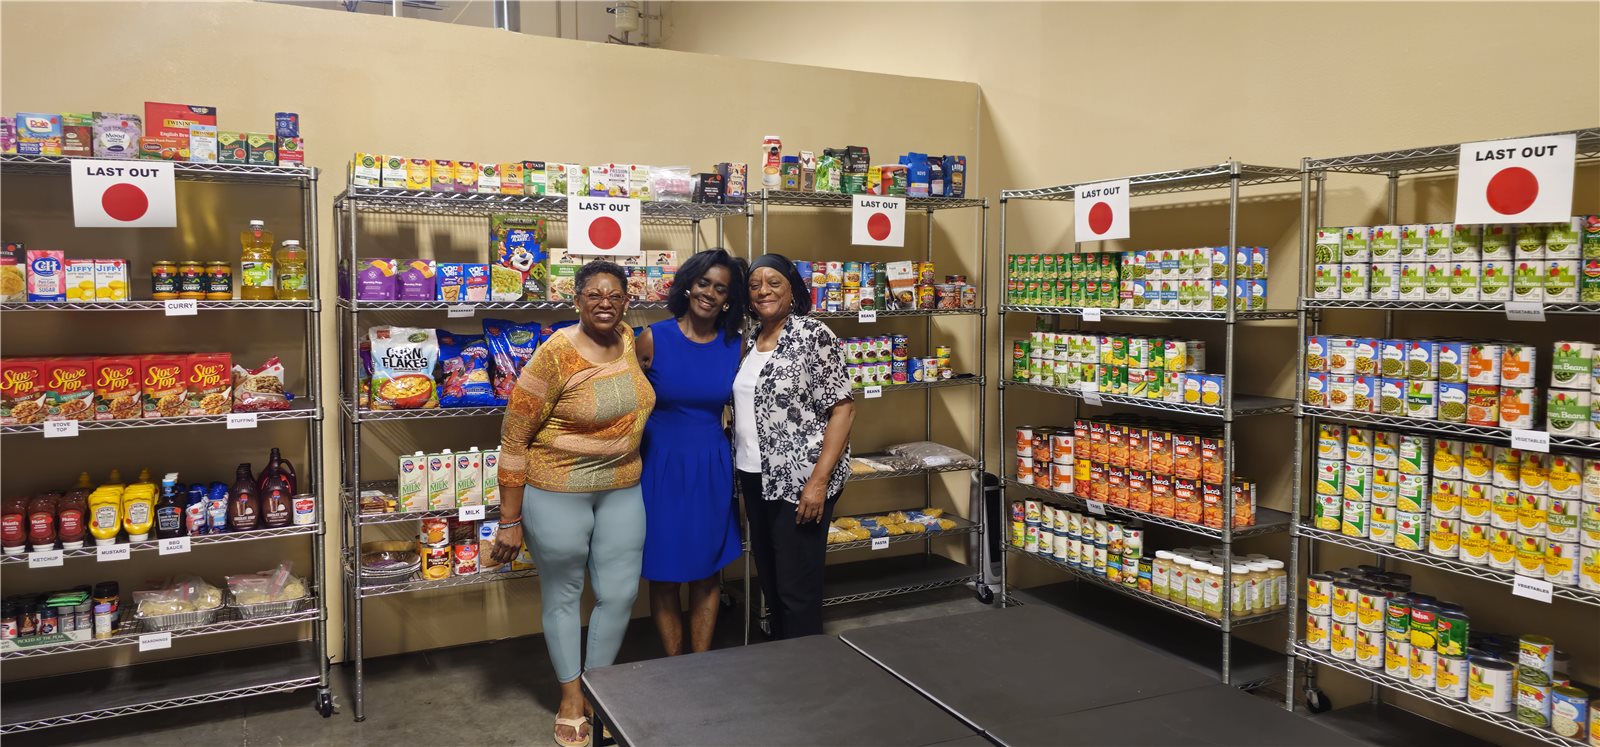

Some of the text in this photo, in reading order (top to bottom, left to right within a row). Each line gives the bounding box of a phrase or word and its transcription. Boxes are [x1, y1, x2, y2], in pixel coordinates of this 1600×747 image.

[30, 119, 49, 129] Dole
[167, 120, 194, 128] TWINING
[1474, 145, 1559, 162] LAST OUT
[86, 166, 160, 178] LAST OUT
[1081, 186, 1121, 199] LAST OUT
[578, 202, 631, 213] LAST OUT
[860, 200, 880, 208] LAST
[66, 265, 94, 273] JIFFY
[381, 357, 428, 369] FLAKES
[1563, 363, 1588, 372] Beans
[48, 368, 87, 389] Stove
[97, 367, 135, 387] Stoe
[202, 375, 220, 386] Top
[14, 381, 34, 394] Top
[62, 380, 82, 393] Top
[110, 378, 130, 391] Top
[158, 377, 176, 389] Top
[1501, 406, 1521, 414] Carrots
[1561, 411, 1586, 419] Beans
[402, 482, 421, 494] MILK
[429, 480, 449, 492] MILK
[457, 479, 476, 490] MILK
[484, 477, 498, 488] MIL
[465, 508, 481, 516] MILK
[1517, 583, 1550, 595] VEGETABLES
[142, 637, 169, 645] SEASONINGS
